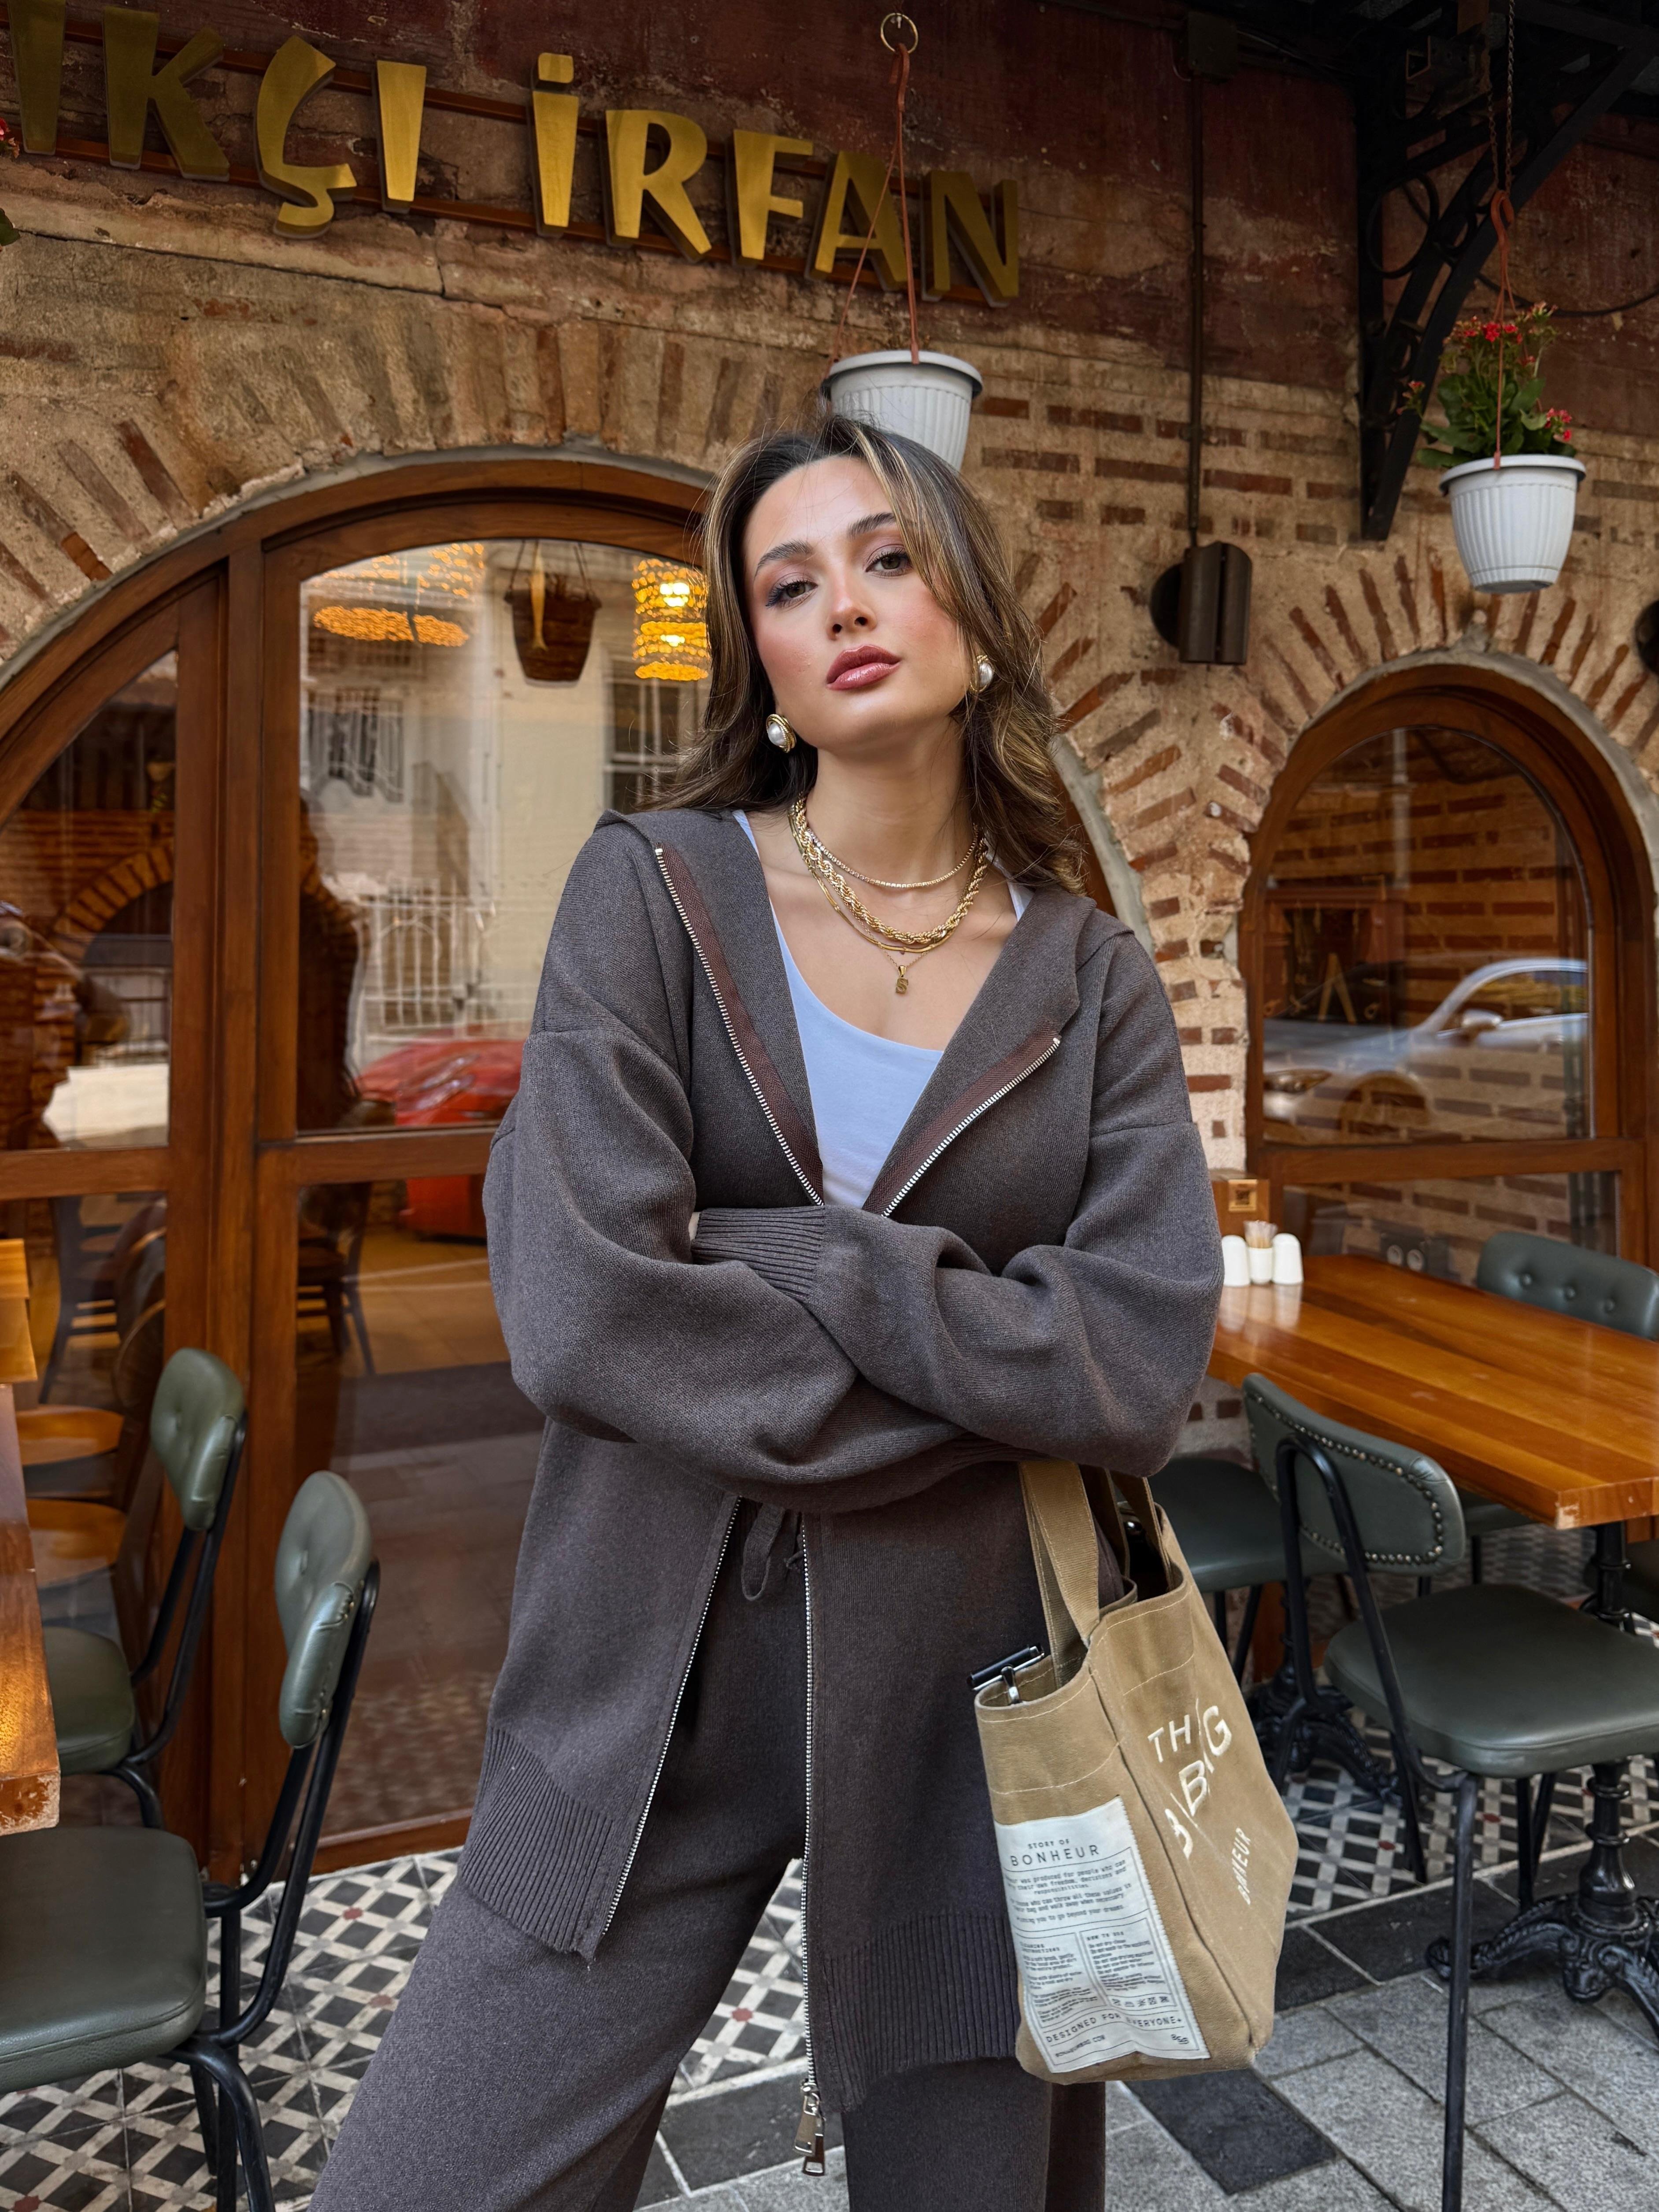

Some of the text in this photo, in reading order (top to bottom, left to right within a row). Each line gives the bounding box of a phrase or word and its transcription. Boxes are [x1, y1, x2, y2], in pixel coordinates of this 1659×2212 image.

[530, 52, 1019, 305] İRFAN
[1010, 1845, 1099, 1866] BONHEUR
[1028, 1841, 1054, 1849] STORY
[1045, 2017, 1096, 2042] DESIGNED
